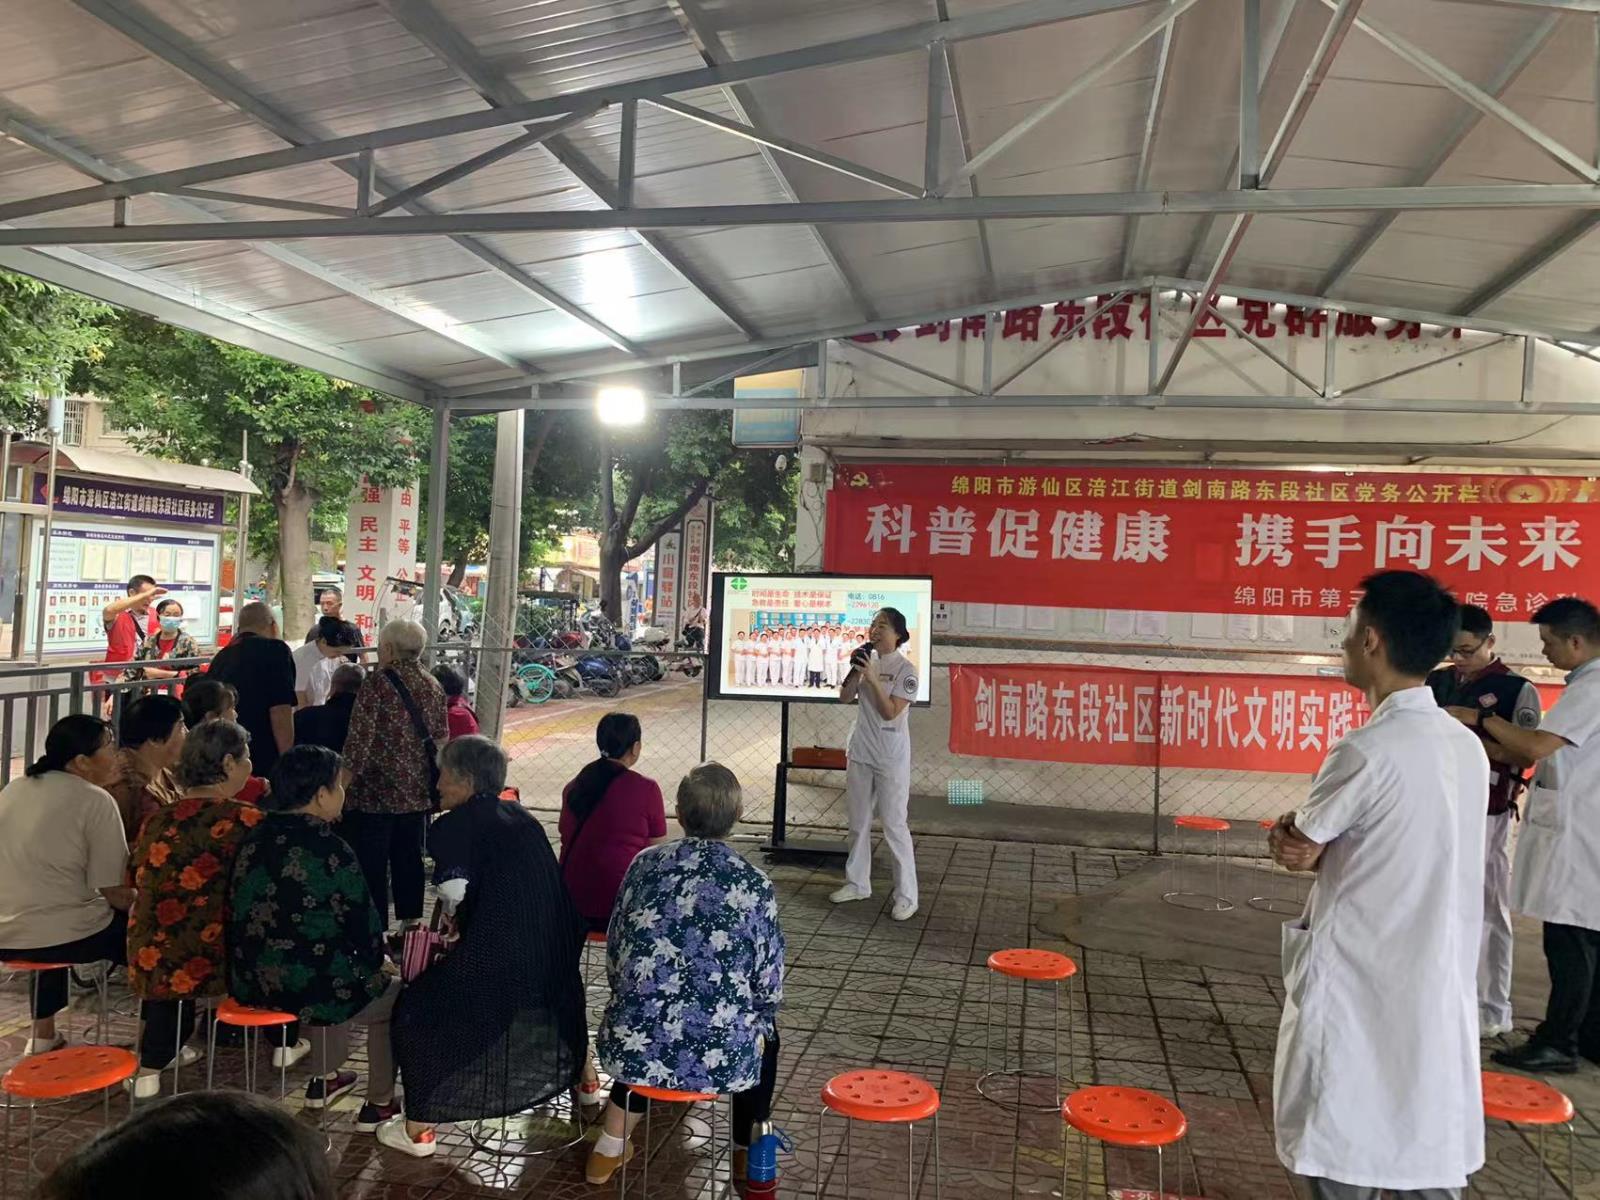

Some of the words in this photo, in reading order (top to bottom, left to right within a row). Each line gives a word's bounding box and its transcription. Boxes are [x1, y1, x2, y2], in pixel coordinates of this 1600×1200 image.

[951, 475, 1483, 503] 绵阳市游仙区涪江街道剑南路东段社区党务公开栏
[358, 516, 378, 553] 民主
[398, 519, 413, 555] 平等
[864, 503, 1171, 563] 科普促健康
[1234, 512, 1583, 571] 携手向未来
[356, 565, 377, 601] 文明
